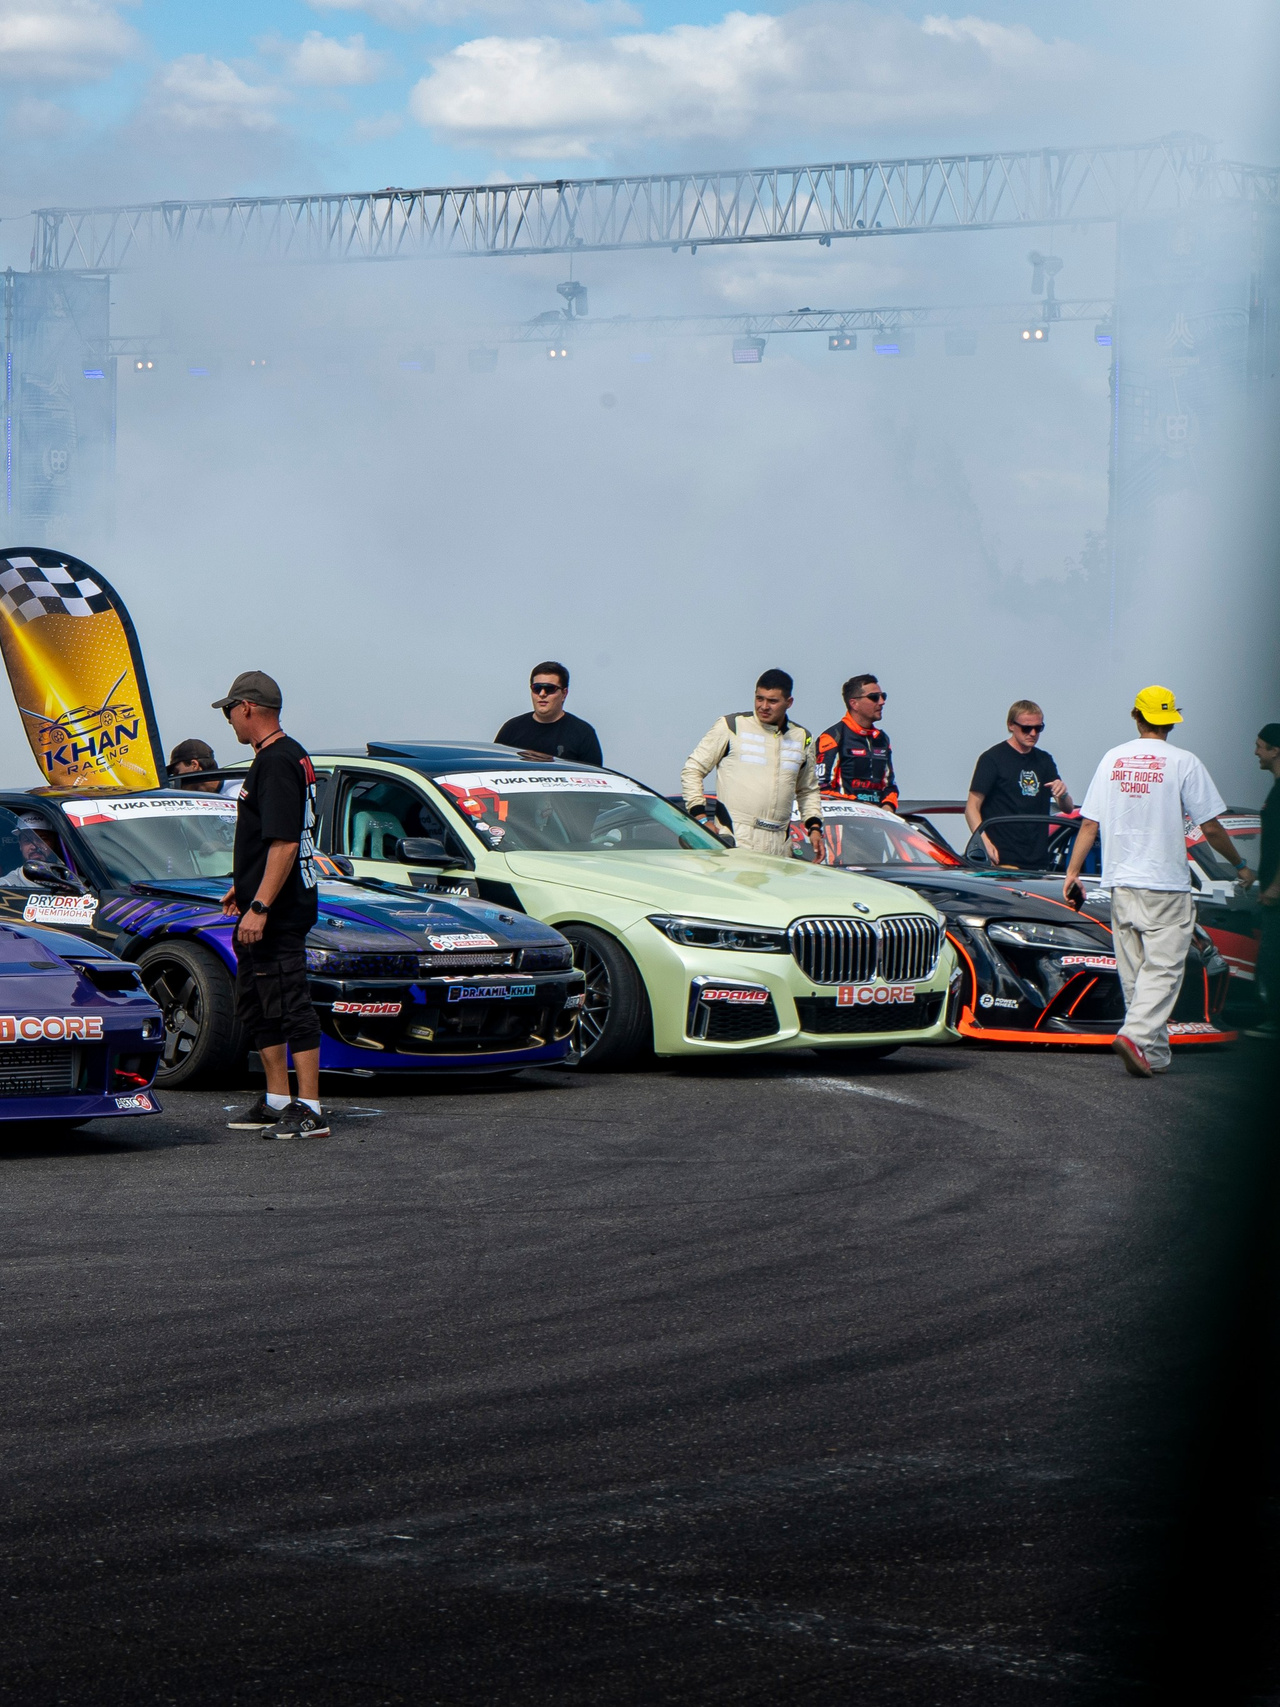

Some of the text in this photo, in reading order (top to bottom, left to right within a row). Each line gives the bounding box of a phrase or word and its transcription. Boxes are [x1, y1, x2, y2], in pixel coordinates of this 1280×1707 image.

[39, 718, 141, 772] KHAN
[67, 745, 129, 775] RACING
[1134, 771, 1164, 783] RIDERS
[1120, 782, 1151, 794] SCHOOL
[109, 802, 150, 811] YUKA
[29, 896, 81, 907] DRYDRY
[39, 909, 93, 918] ЧЕМПИОНАТ
[1062, 956, 1117, 965] ДРАЙВ
[461, 985, 535, 999] DR.KAMIL_KHAN
[703, 989, 768, 1000] ДРАЙВ
[332, 1002, 401, 1013] ДРАЙВ
